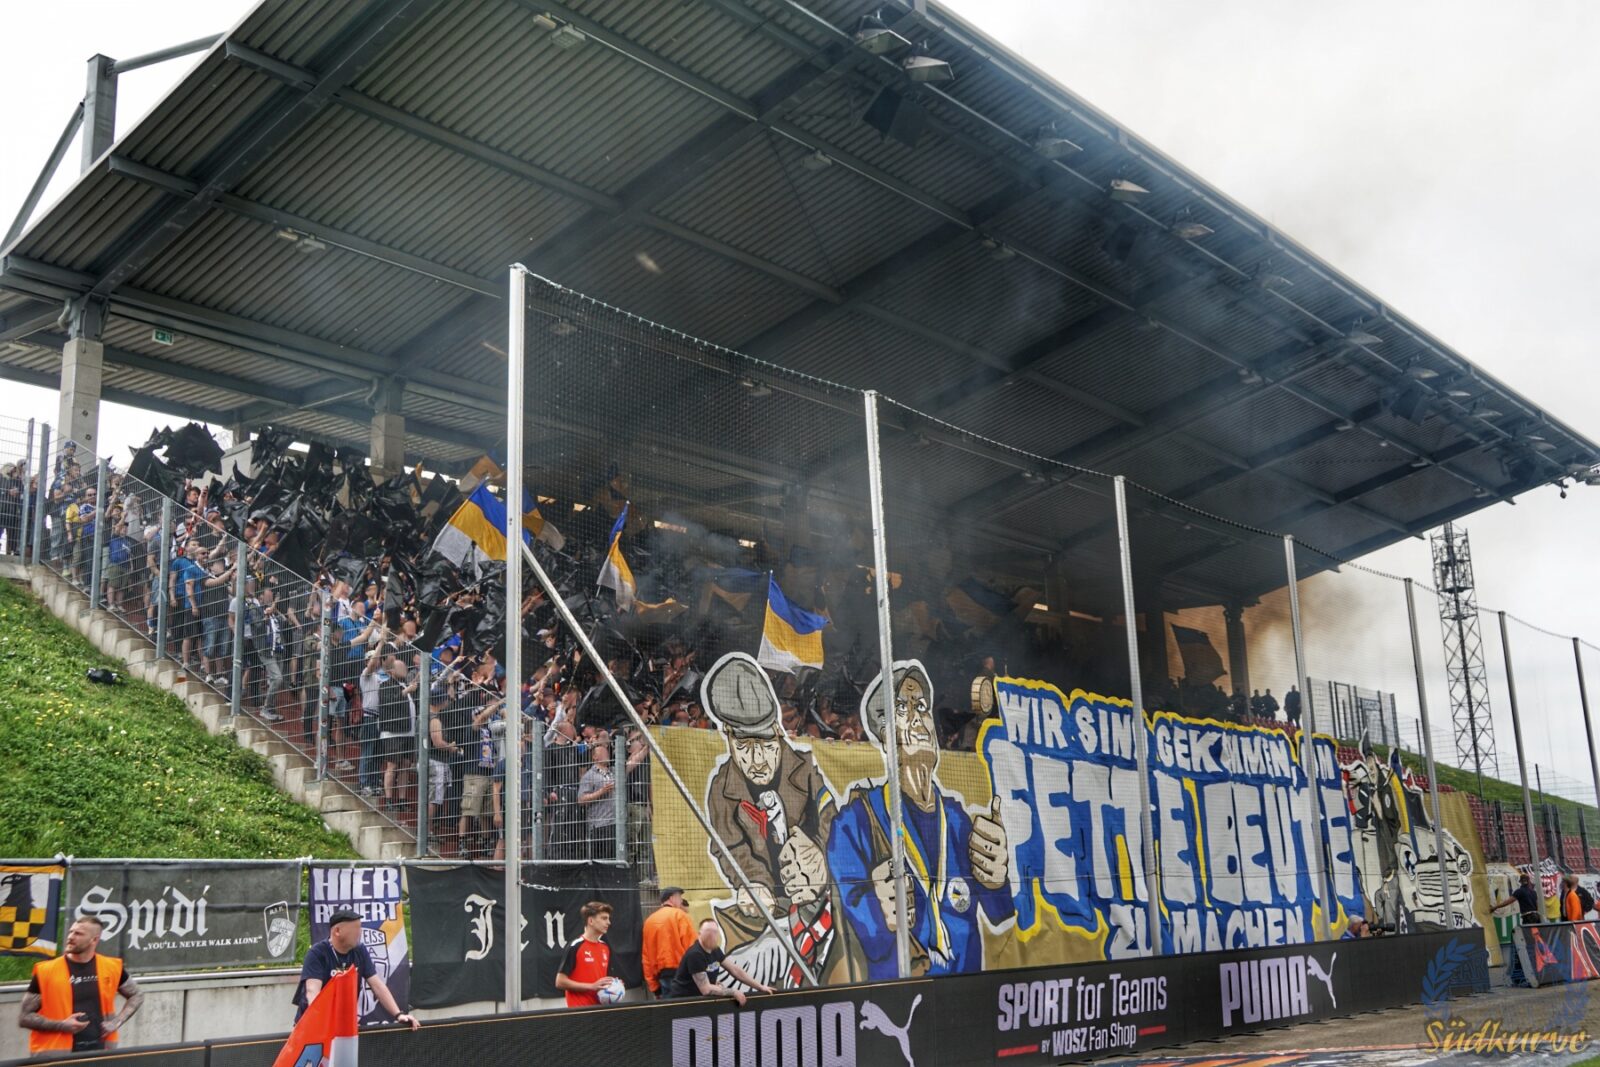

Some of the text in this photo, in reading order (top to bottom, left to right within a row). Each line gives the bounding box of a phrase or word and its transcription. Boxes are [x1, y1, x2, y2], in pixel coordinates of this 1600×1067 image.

[998, 691, 1068, 749] WIR
[988, 739, 1355, 905] FETTE BEUTE
[312, 867, 400, 901] HIER
[179, 939, 207, 949] NEVER
[208, 937, 231, 947] WALK
[1170, 906, 1305, 954] MACHEN
[998, 973, 1167, 1031] SPORT for Teams
[1219, 955, 1309, 1027] PUMA
[1041, 1021, 1137, 1057] BY WOSZ Fan Shop
